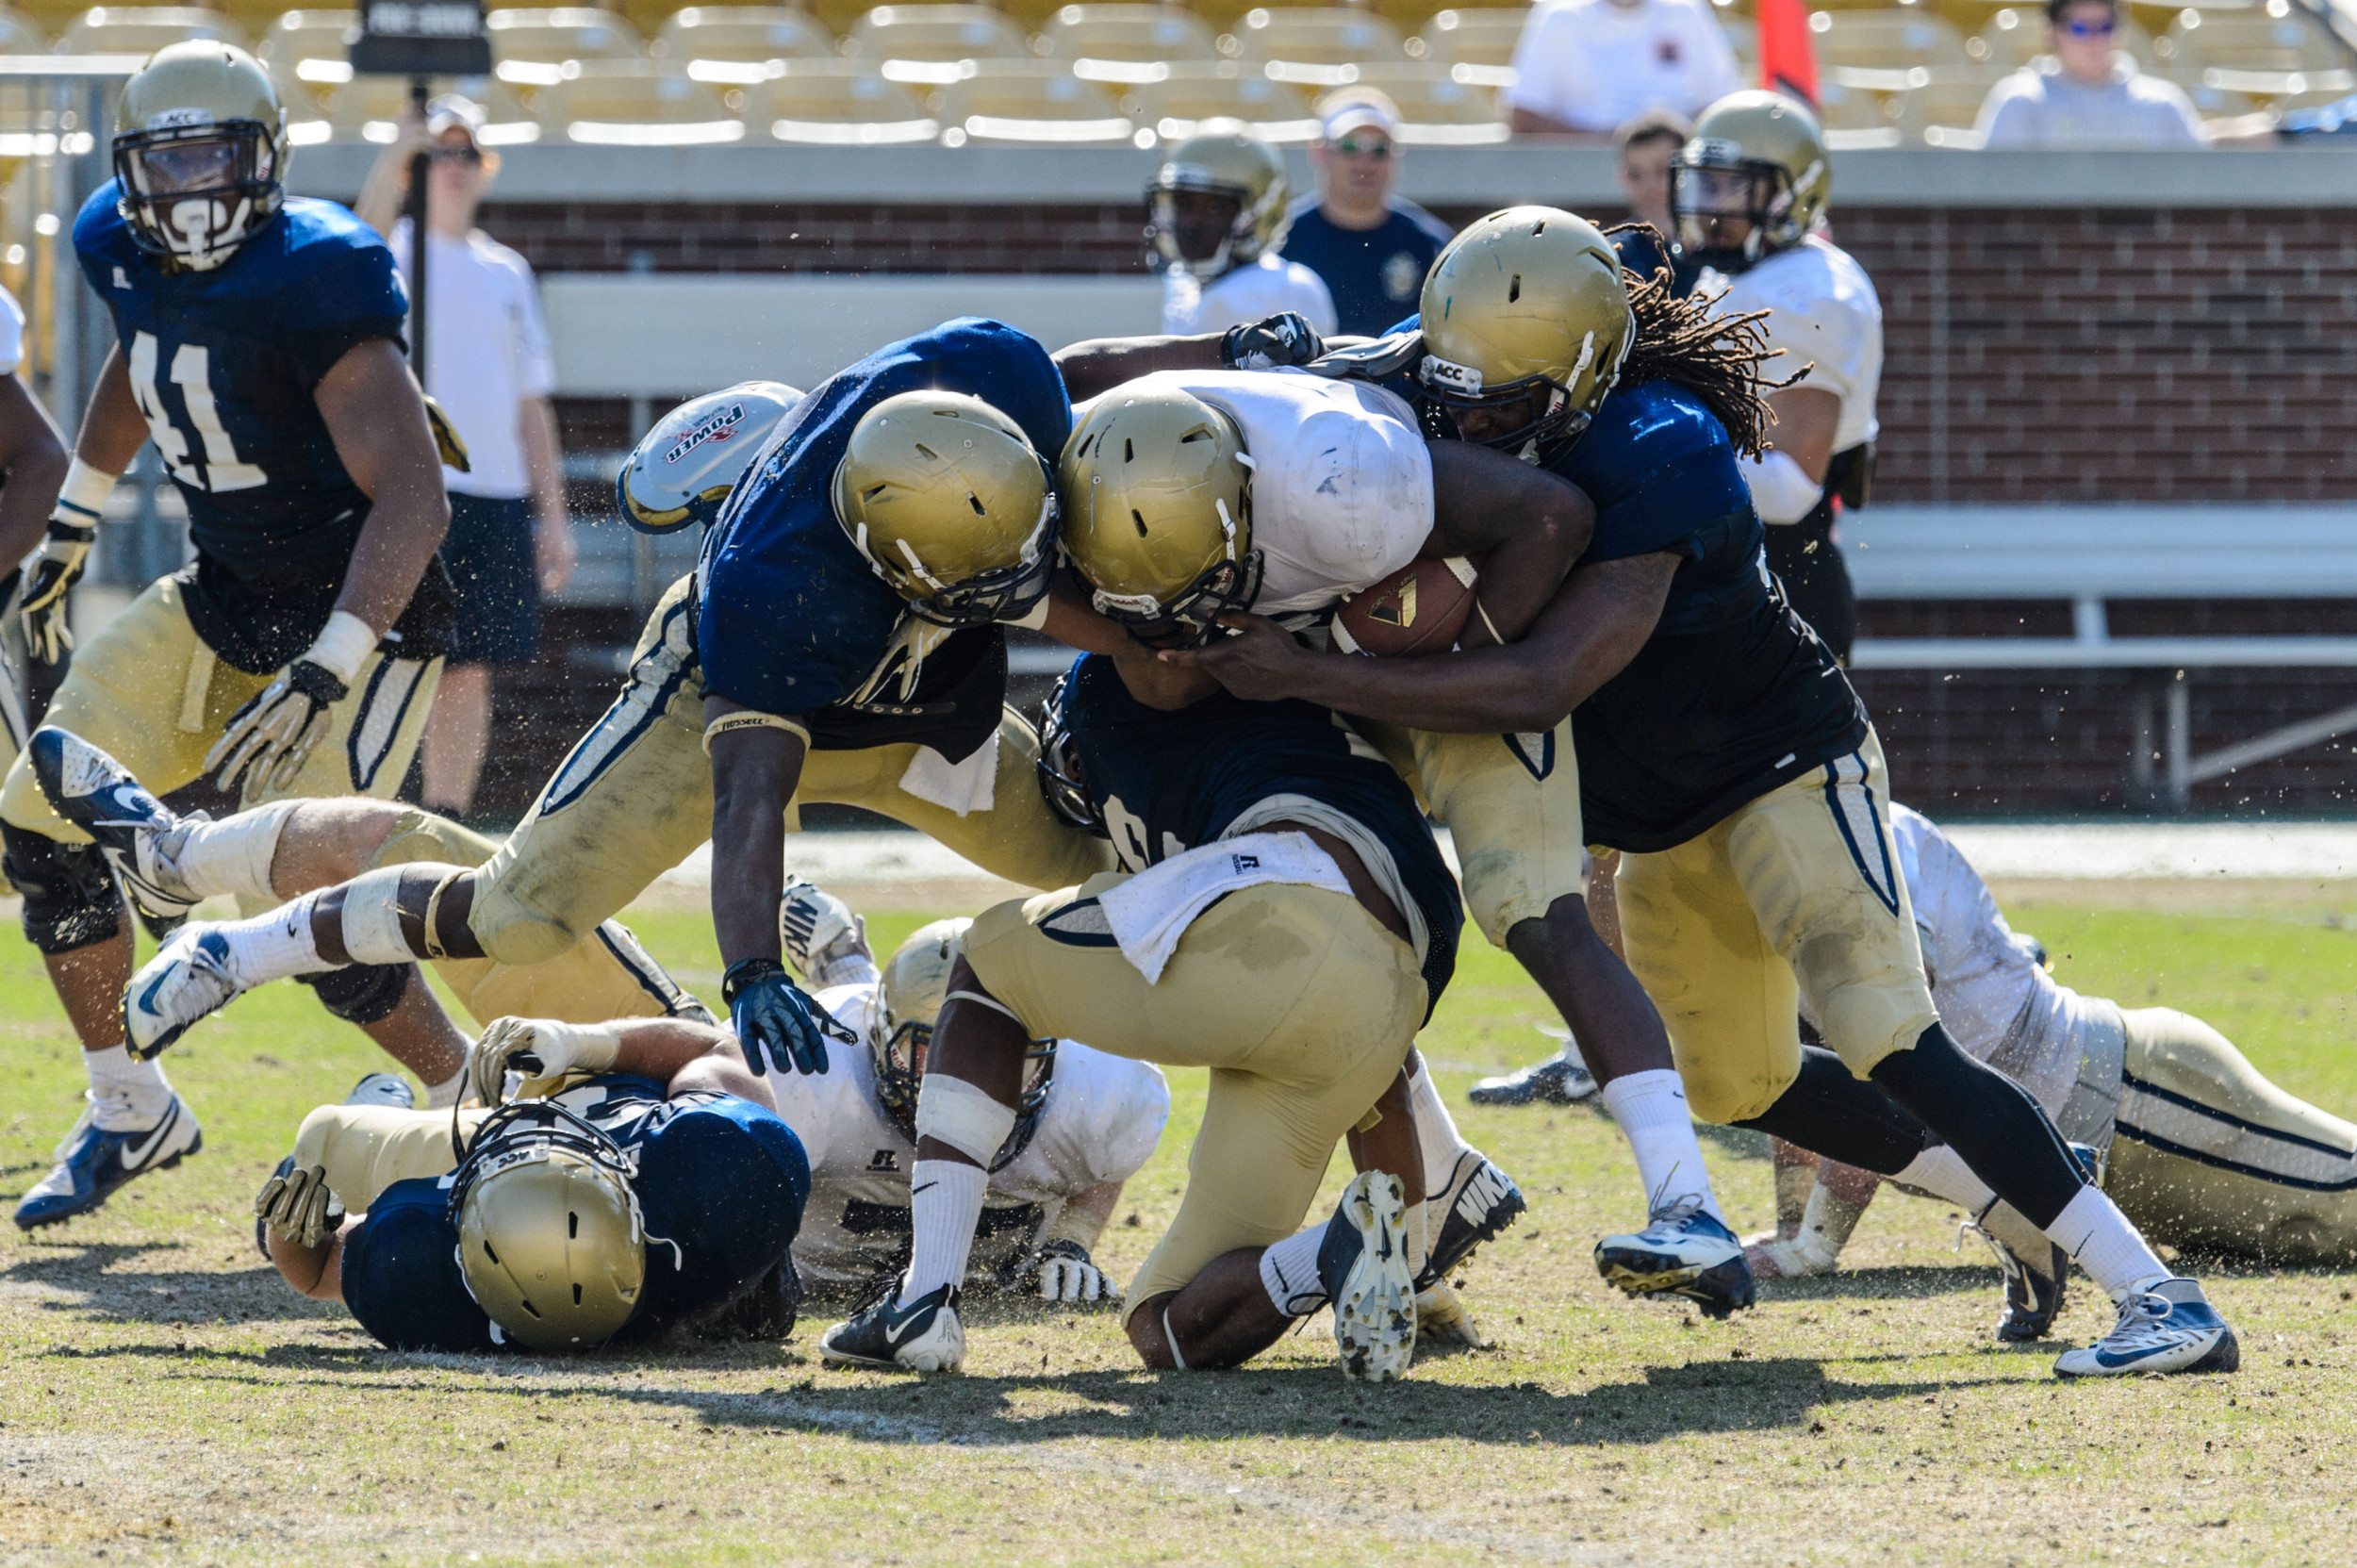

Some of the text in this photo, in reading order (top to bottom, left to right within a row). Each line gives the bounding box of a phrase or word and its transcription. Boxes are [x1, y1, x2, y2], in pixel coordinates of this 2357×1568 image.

[166, 114, 192, 125] ACC
[1435, 363, 1463, 381] ACC
[128, 330, 268, 492] 41
[722, 718, 764, 731] RUSSELL
[498, 1151, 530, 1168] ACC
